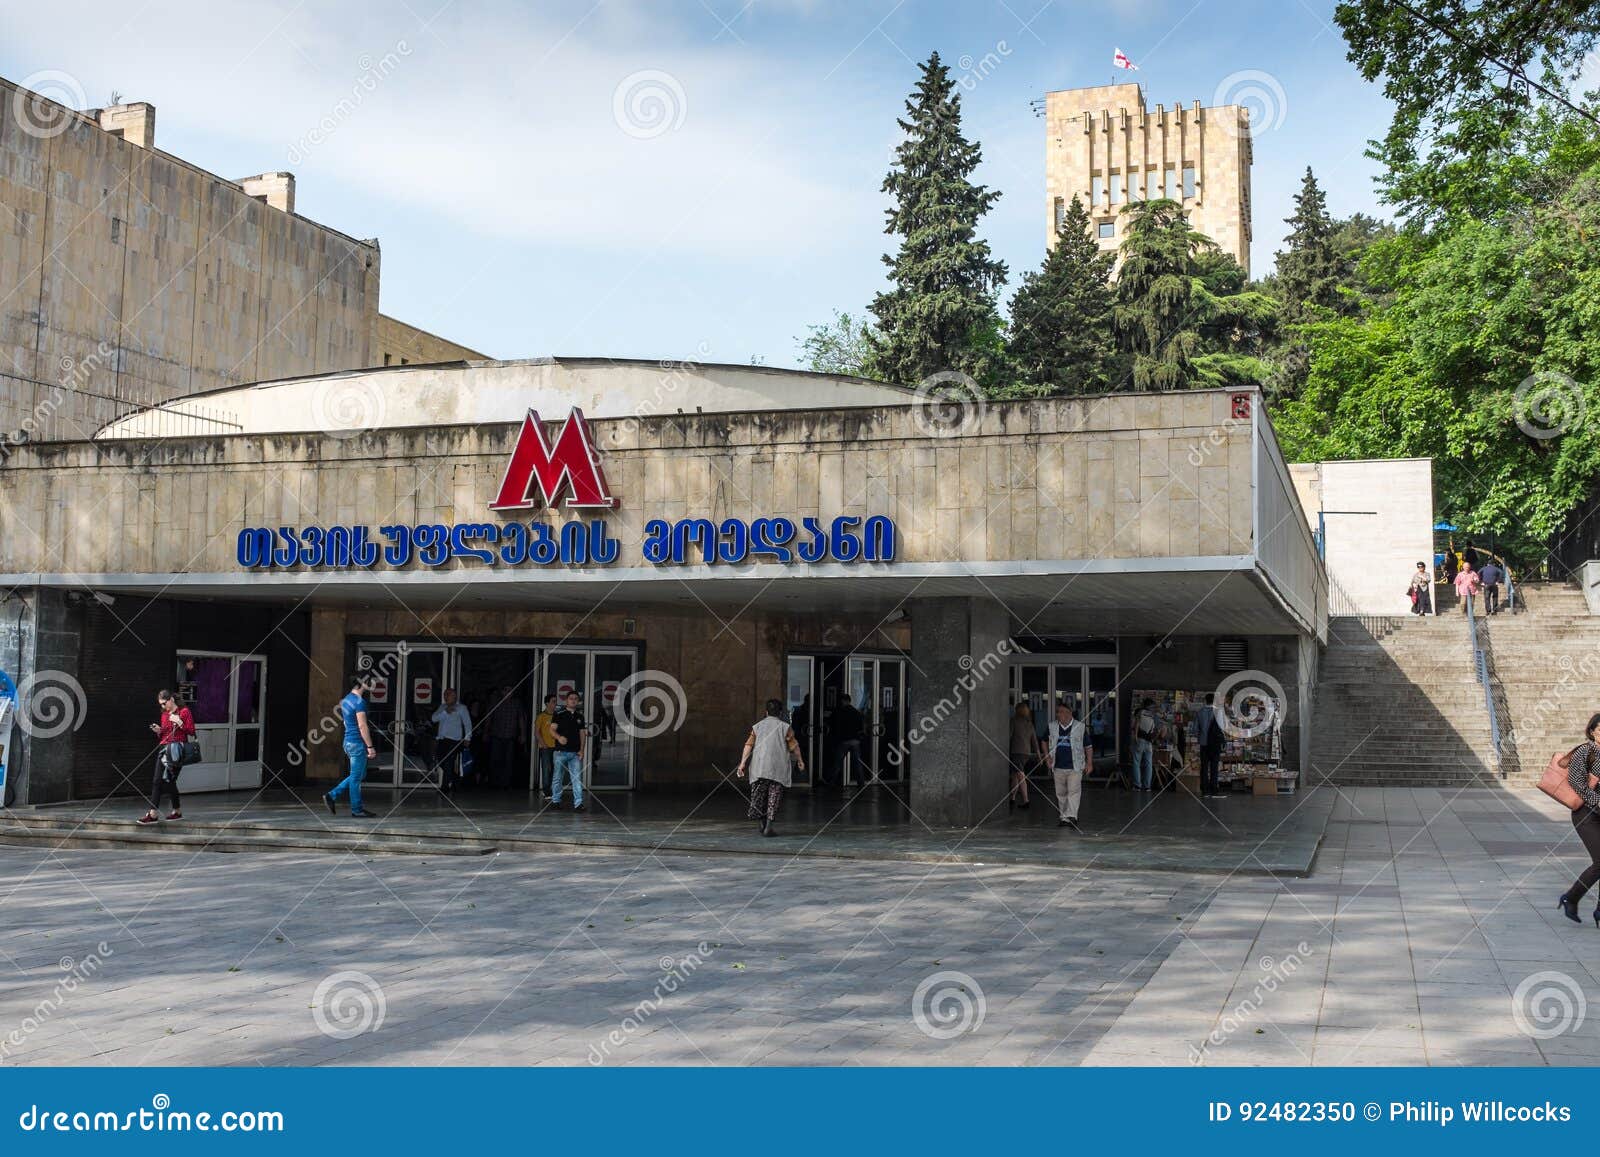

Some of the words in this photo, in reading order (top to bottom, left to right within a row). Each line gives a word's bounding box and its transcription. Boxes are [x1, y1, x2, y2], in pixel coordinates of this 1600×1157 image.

[487, 406, 620, 511] M
[236, 520, 622, 569] თავისუფლების
[642, 514, 898, 564] მოედანი
